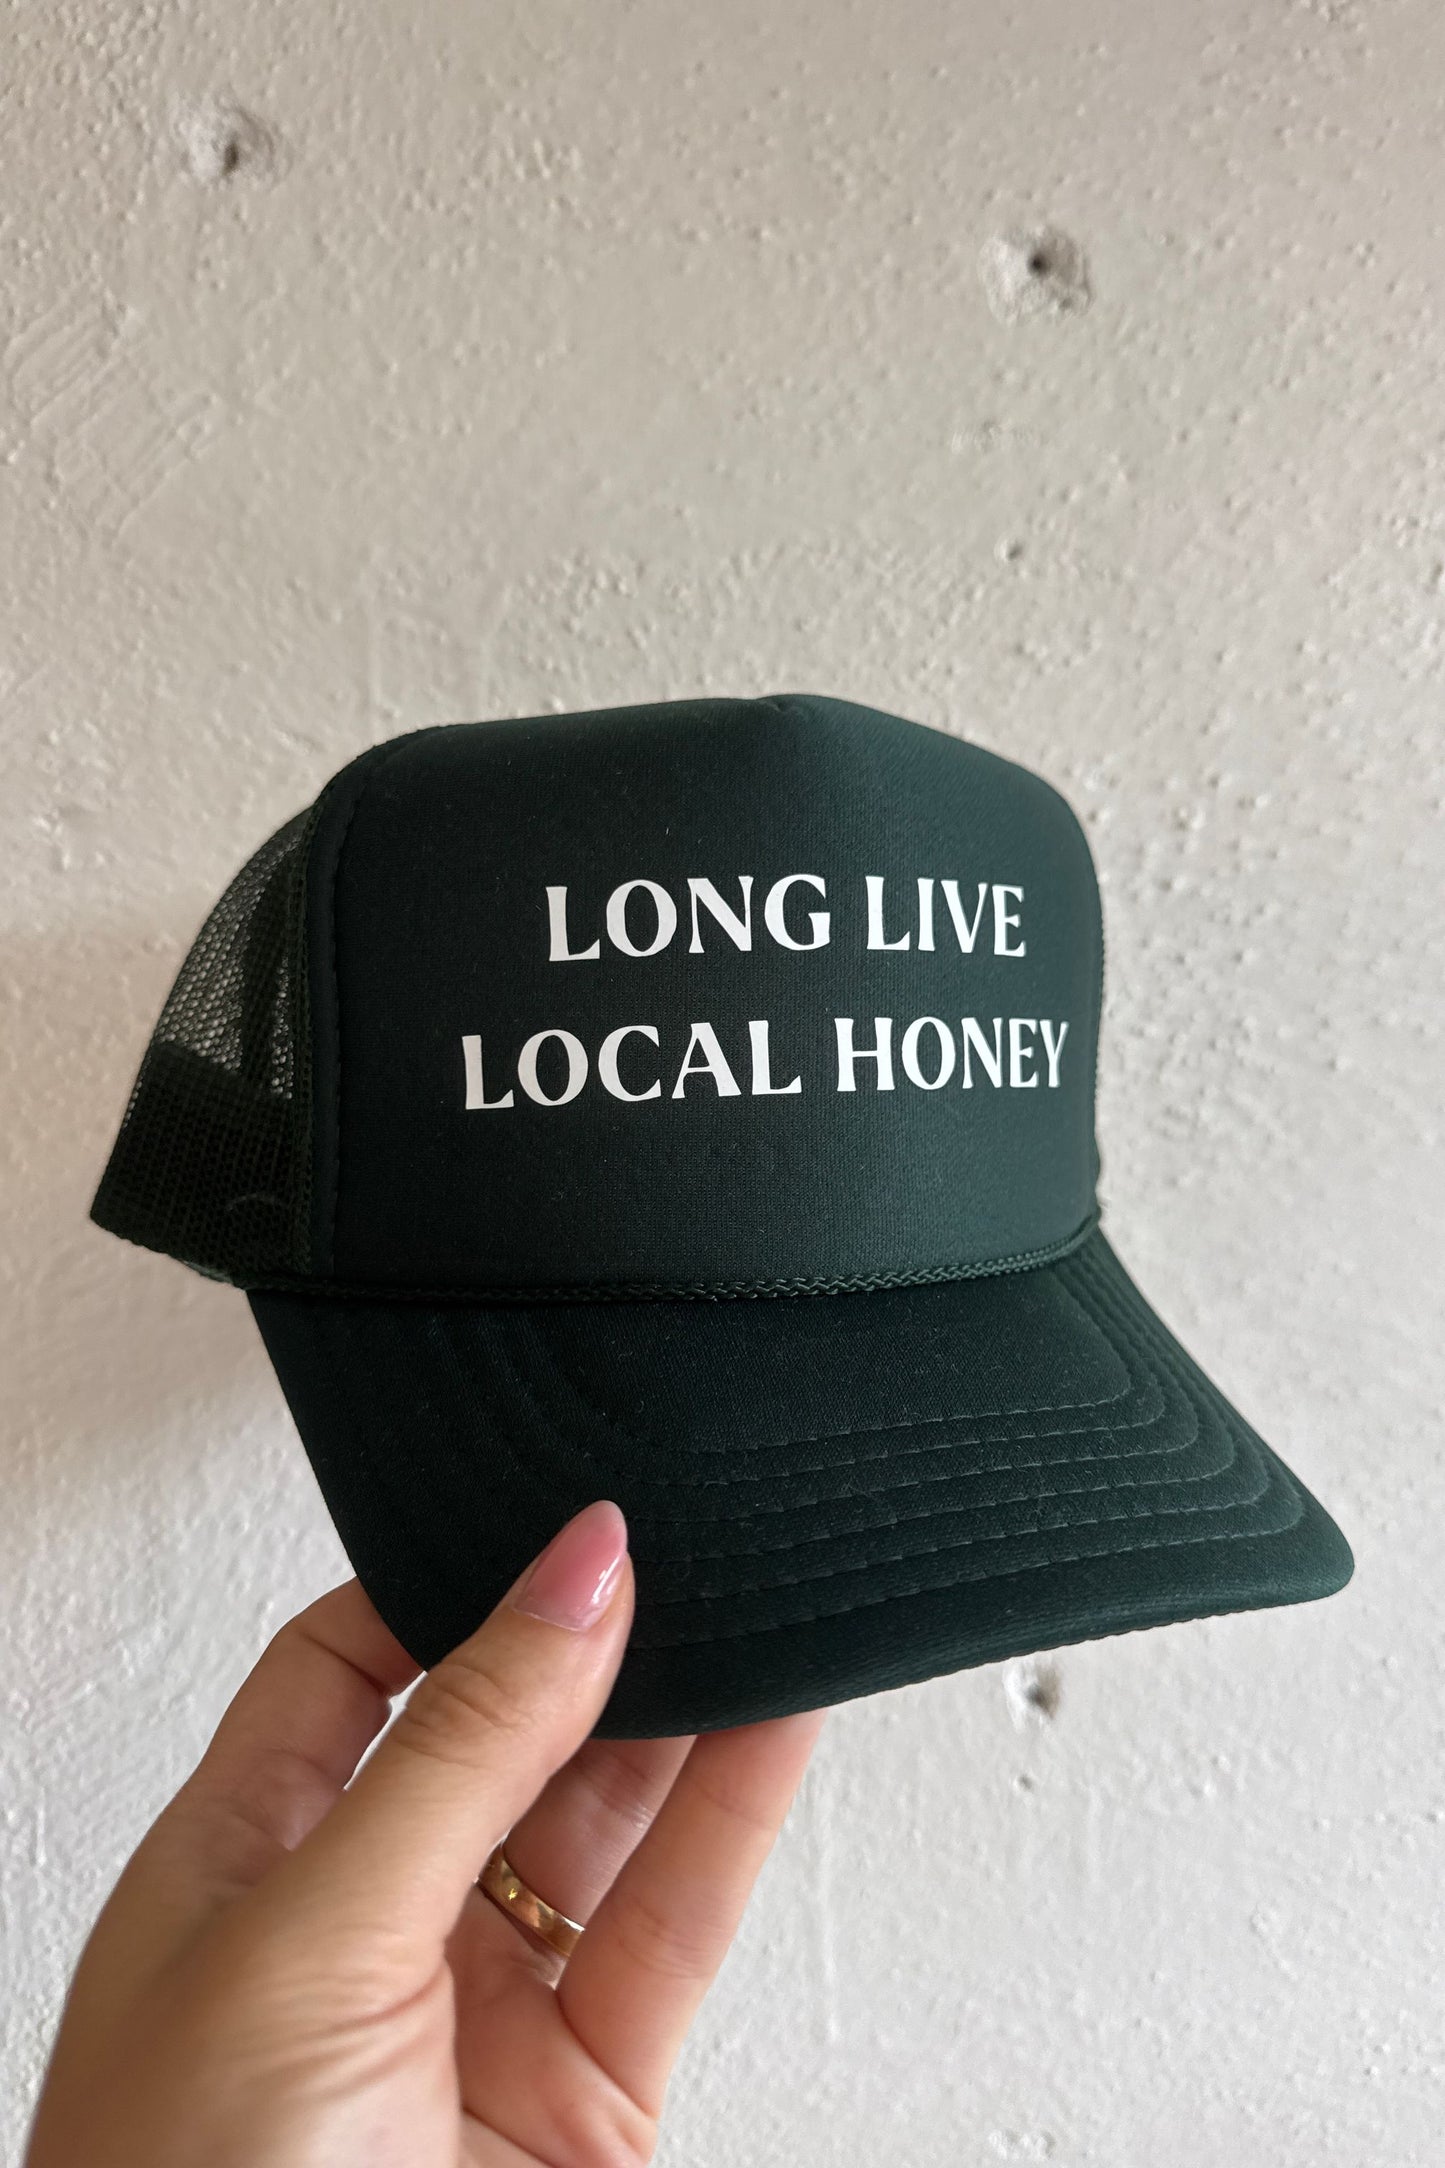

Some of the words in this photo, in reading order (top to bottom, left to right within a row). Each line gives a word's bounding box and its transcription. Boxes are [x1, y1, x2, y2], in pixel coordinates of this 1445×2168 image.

[545, 873, 831, 962] LONG
[864, 875, 1028, 958] LIVE
[461, 1019, 803, 1110] LOCAL
[833, 1016, 1070, 1092] HONEY
